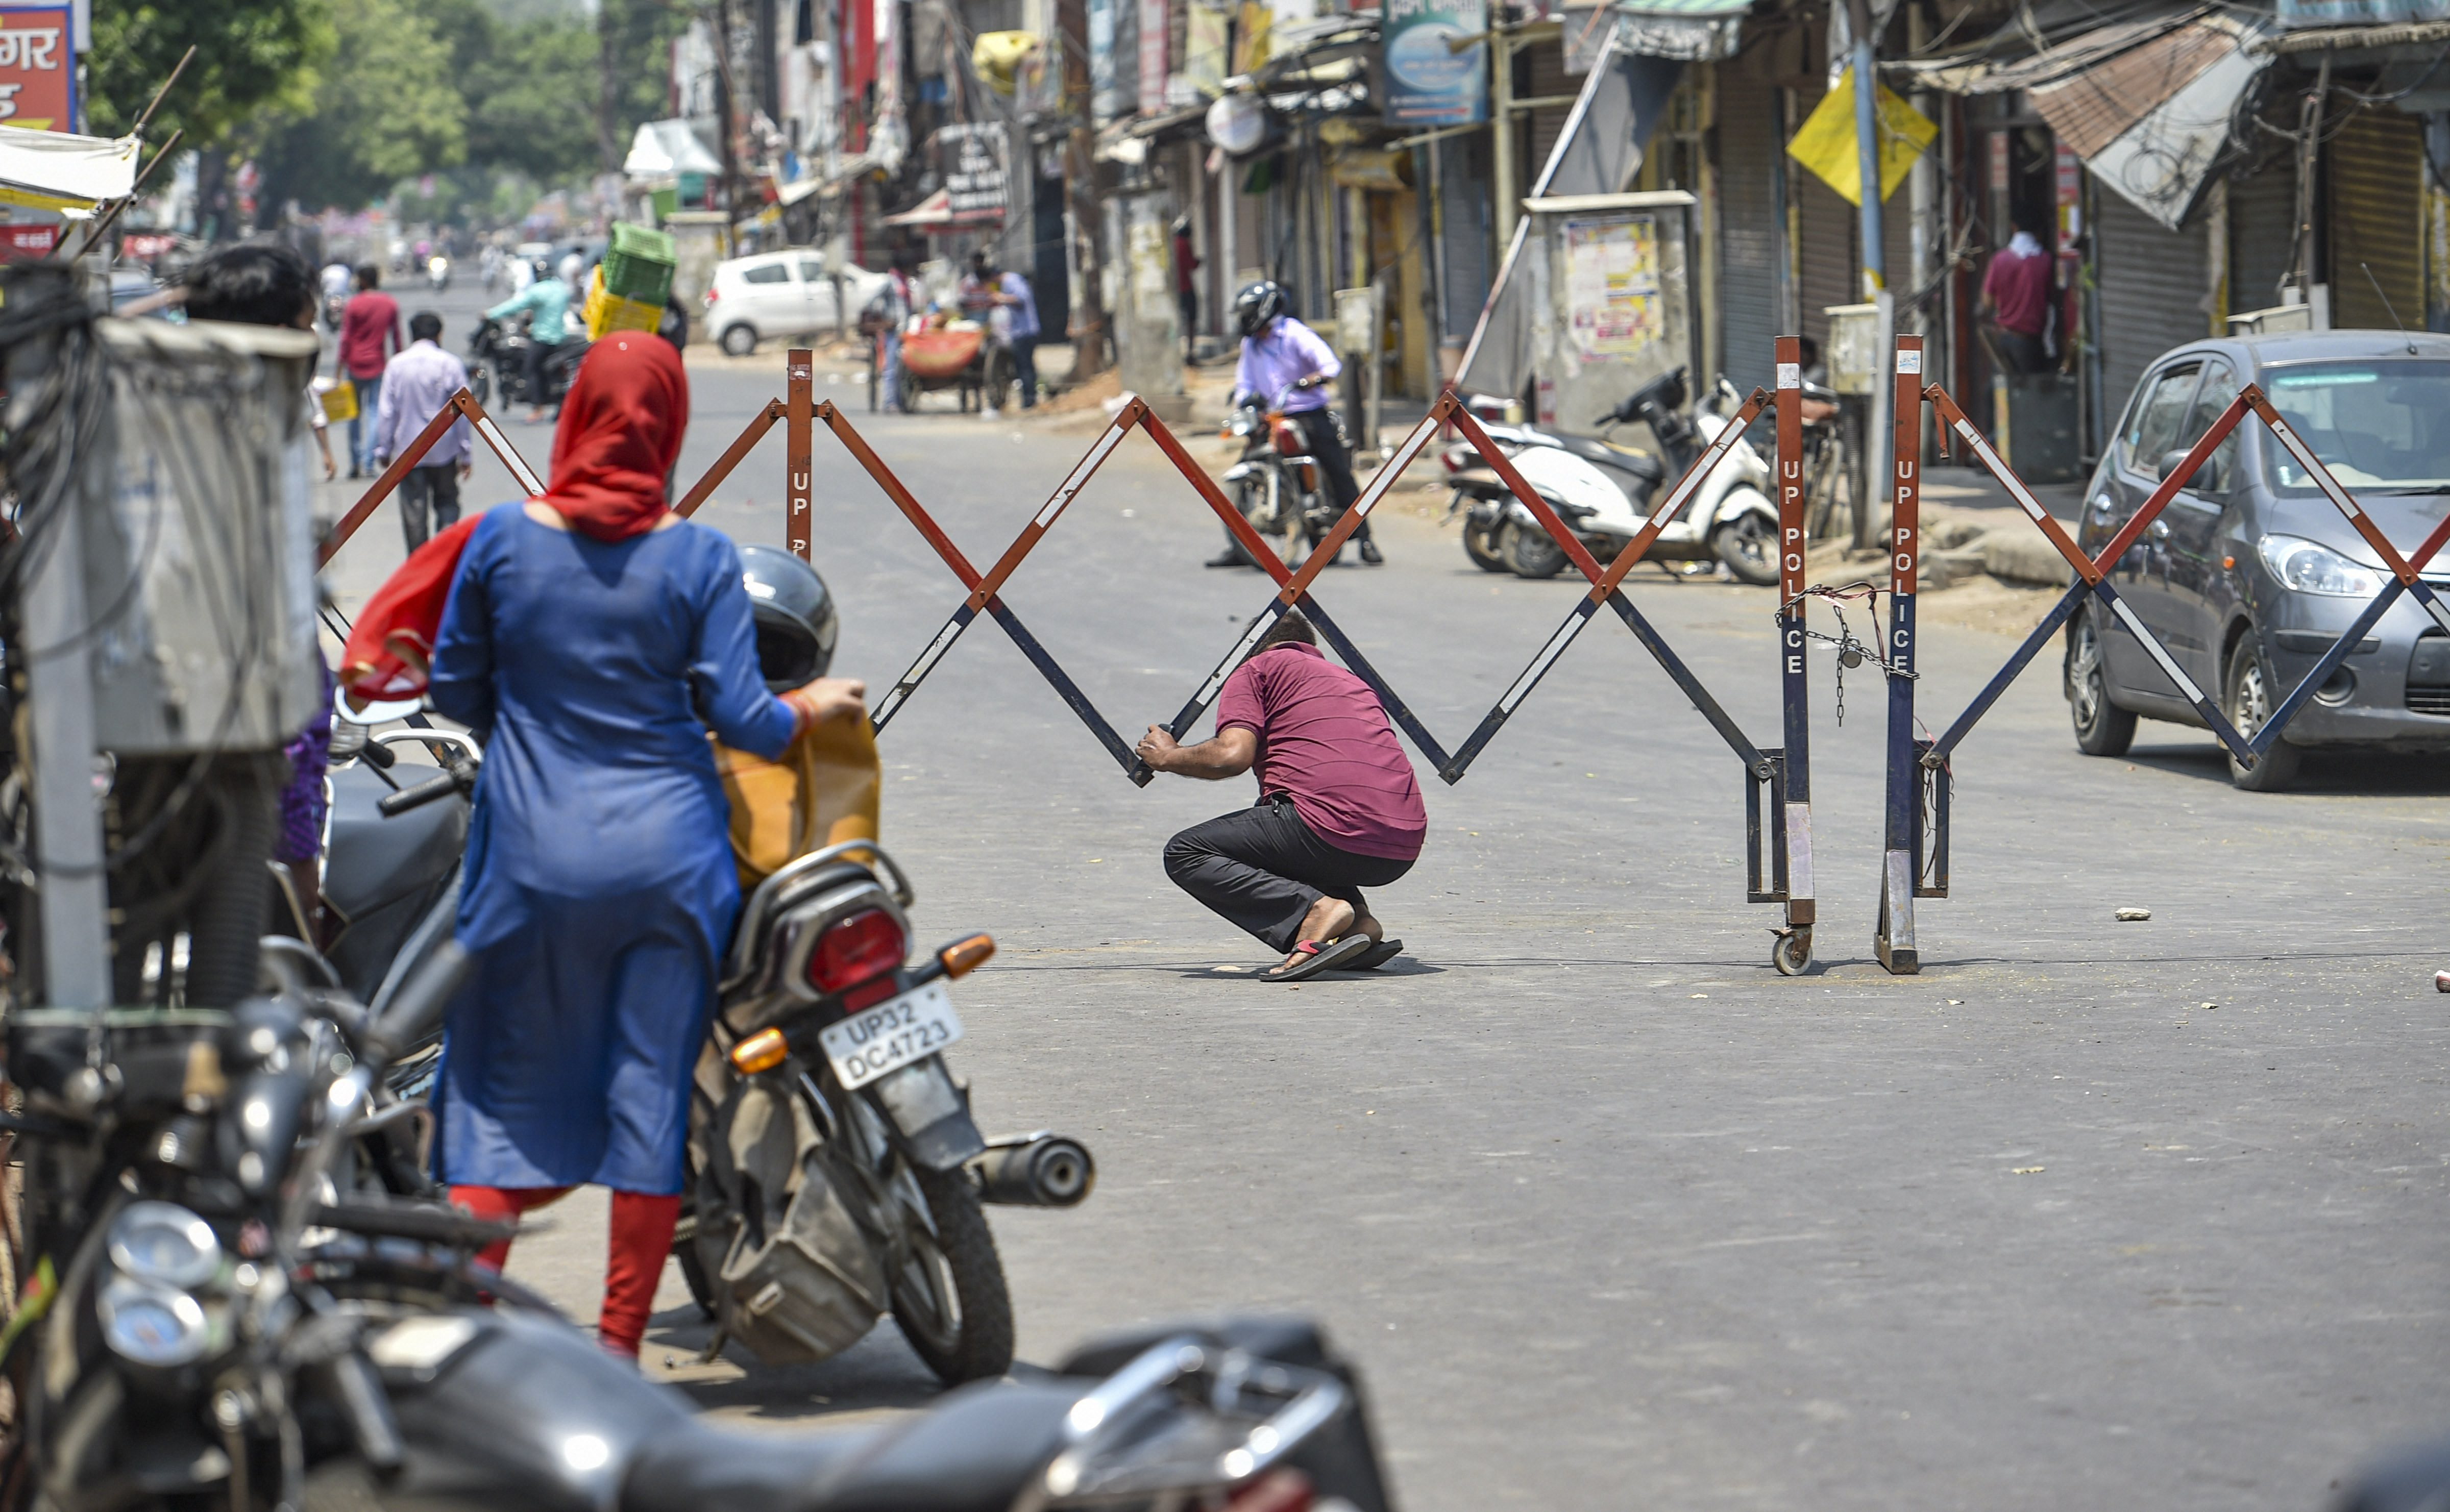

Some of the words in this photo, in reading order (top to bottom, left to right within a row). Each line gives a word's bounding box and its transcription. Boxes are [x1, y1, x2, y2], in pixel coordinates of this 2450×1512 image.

[794, 473, 808, 515] UP
[1784, 461, 1799, 504] UP
[1898, 461, 1913, 504] UP
[1784, 528, 1803, 674] POLICE
[1894, 528, 1912, 673] POLICE
[845, 1001, 917, 1045] UP32
[846, 1020, 950, 1079] DC4723
